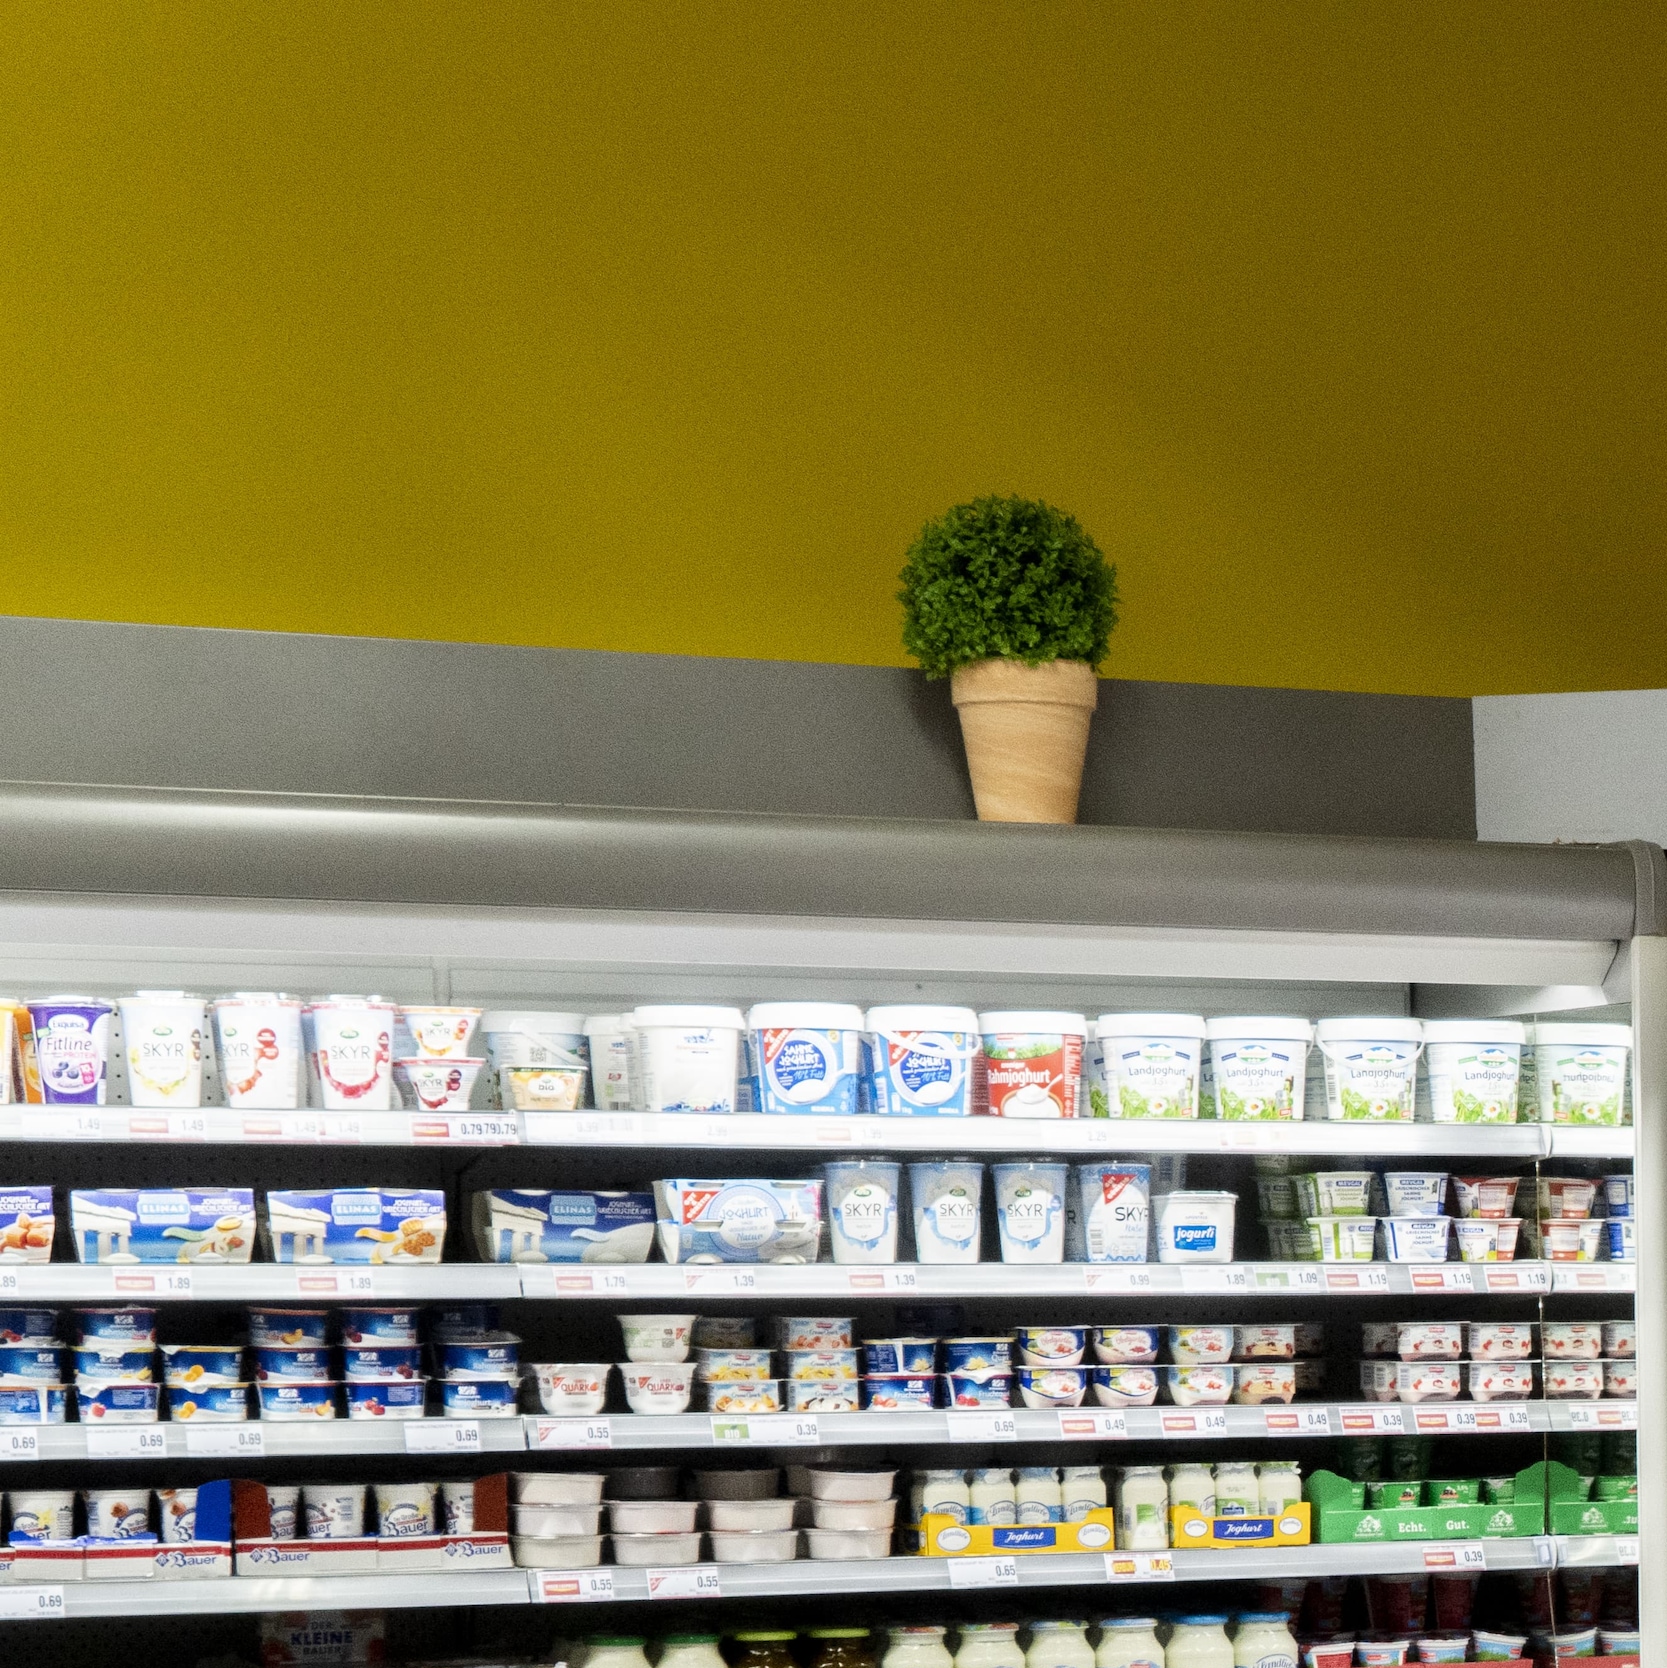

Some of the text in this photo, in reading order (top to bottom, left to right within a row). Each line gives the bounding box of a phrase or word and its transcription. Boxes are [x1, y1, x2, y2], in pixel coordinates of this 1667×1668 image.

[330, 1041, 375, 1060] SKYR
[1127, 1066, 1191, 1080] Landjoghurt
[145, 1204, 187, 1216] ELINAS
[843, 1201, 884, 1220] SKYR
[1398, 1519, 1471, 1533] Echt. Gut.
[1002, 1529, 1049, 1546] Joghurt
[271, 1549, 311, 1564] Bauer
